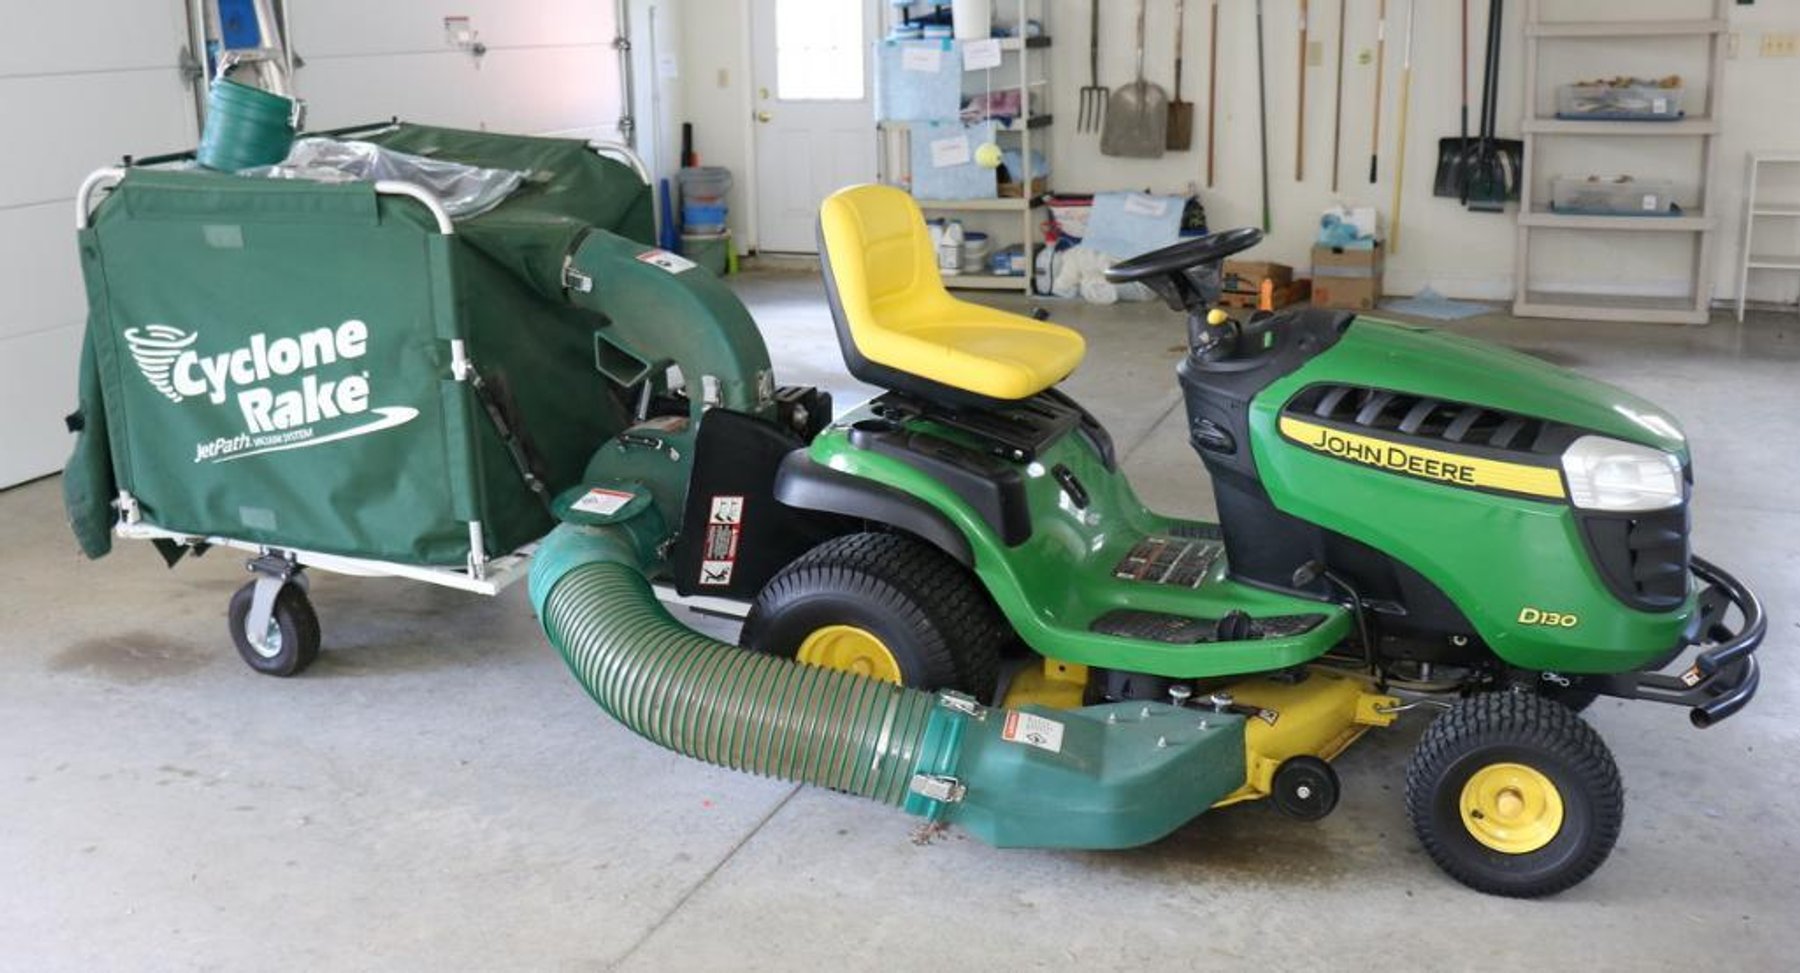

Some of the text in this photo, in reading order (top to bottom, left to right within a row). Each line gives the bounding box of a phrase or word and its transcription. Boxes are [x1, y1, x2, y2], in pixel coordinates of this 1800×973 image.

[173, 319, 368, 405] Cyclone
[237, 374, 370, 434] Rake
[1313, 430, 1476, 483] JOHN DEERE
[1517, 607, 1578, 628] D130
